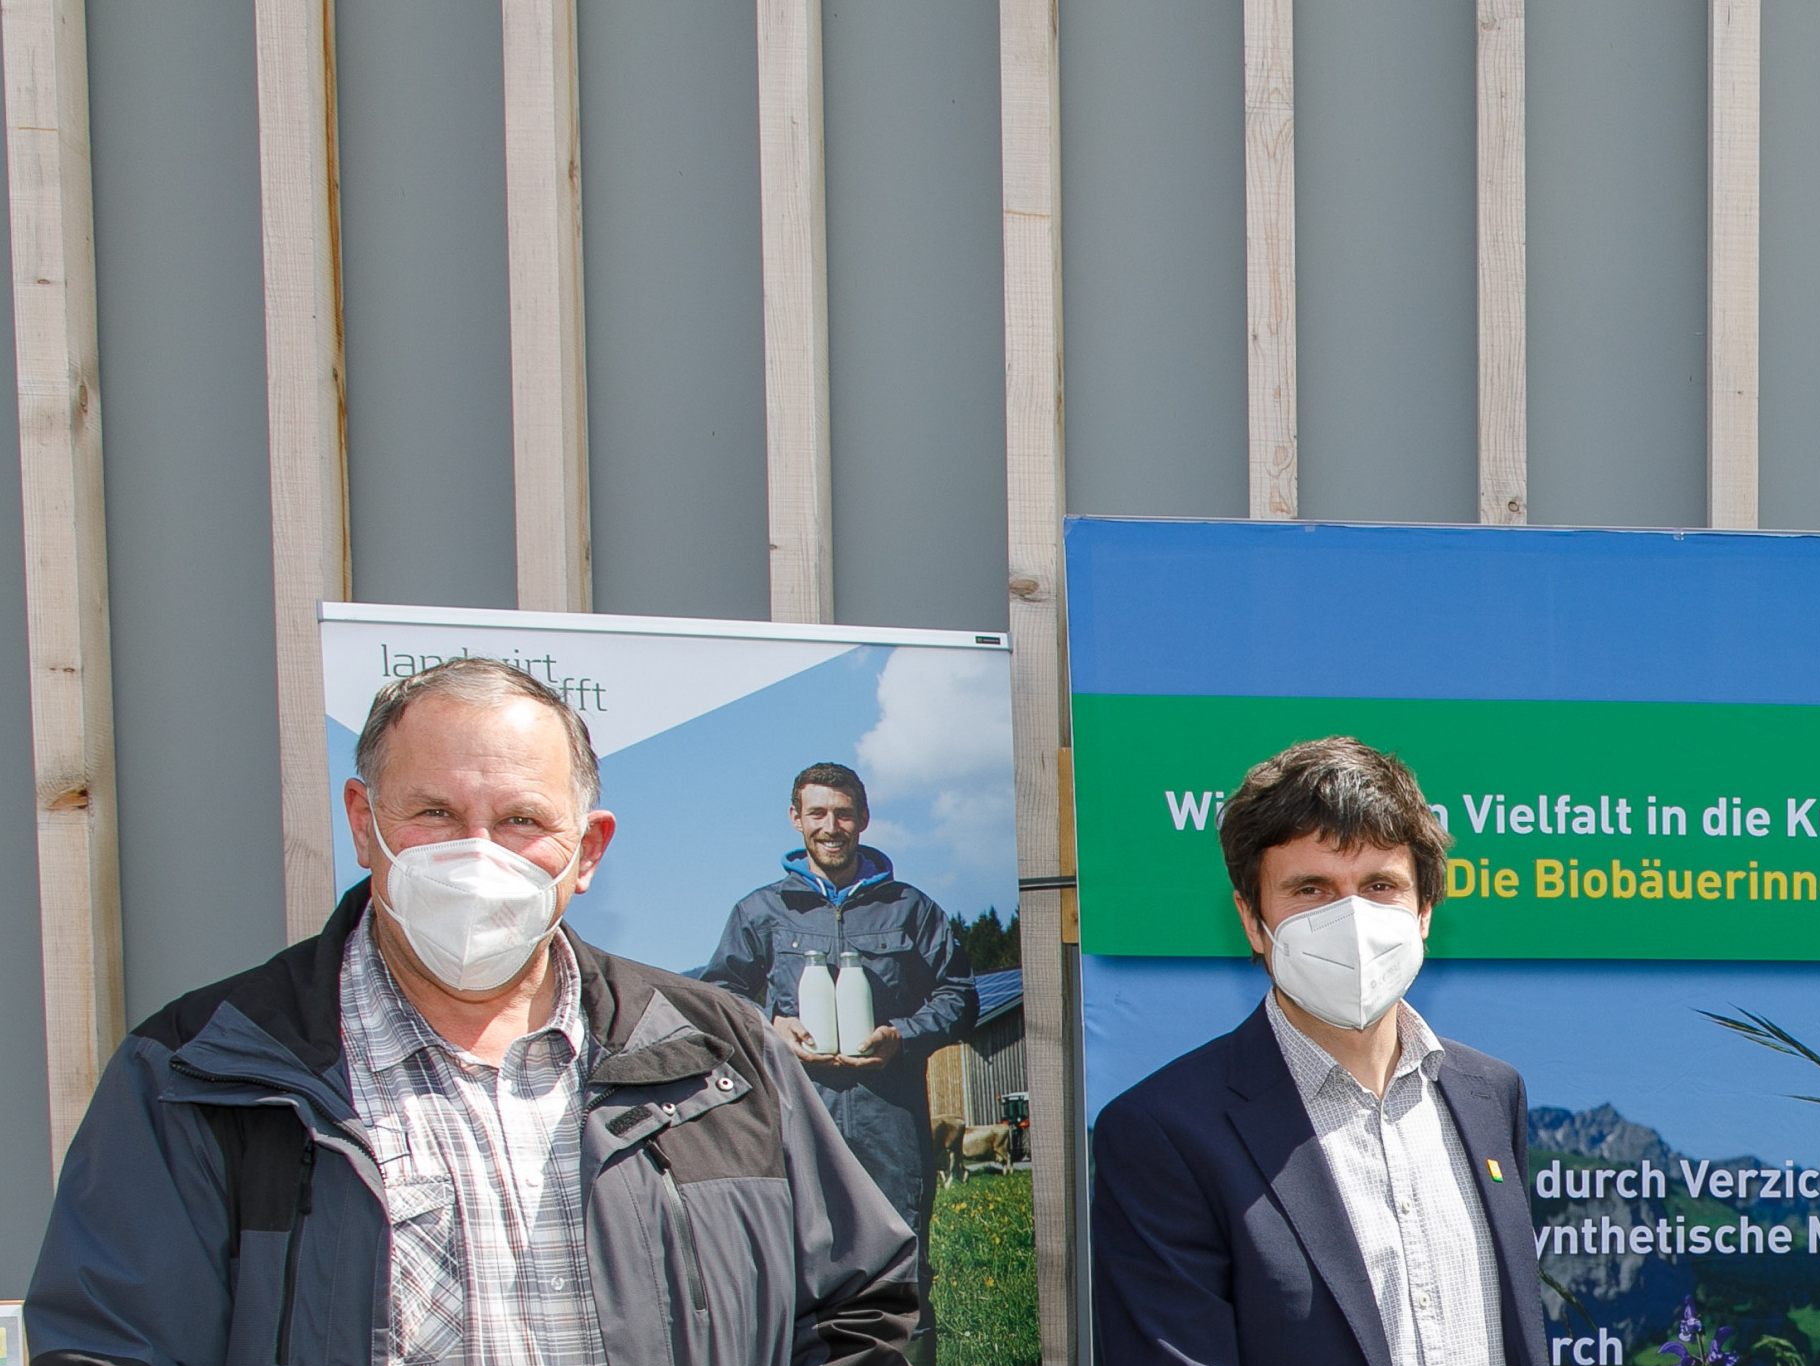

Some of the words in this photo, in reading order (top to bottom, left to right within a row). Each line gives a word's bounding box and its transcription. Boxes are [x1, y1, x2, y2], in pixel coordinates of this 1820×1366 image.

[1463, 794, 1632, 834] Vielfalt
[1647, 796, 1687, 835] in
[1702, 797, 1771, 837] die
[1447, 858, 1519, 898] Die
[1536, 1160, 1666, 1198] durch
[1533, 1215, 1792, 1261] ynthetische
[1552, 1328, 1623, 1366] rch
